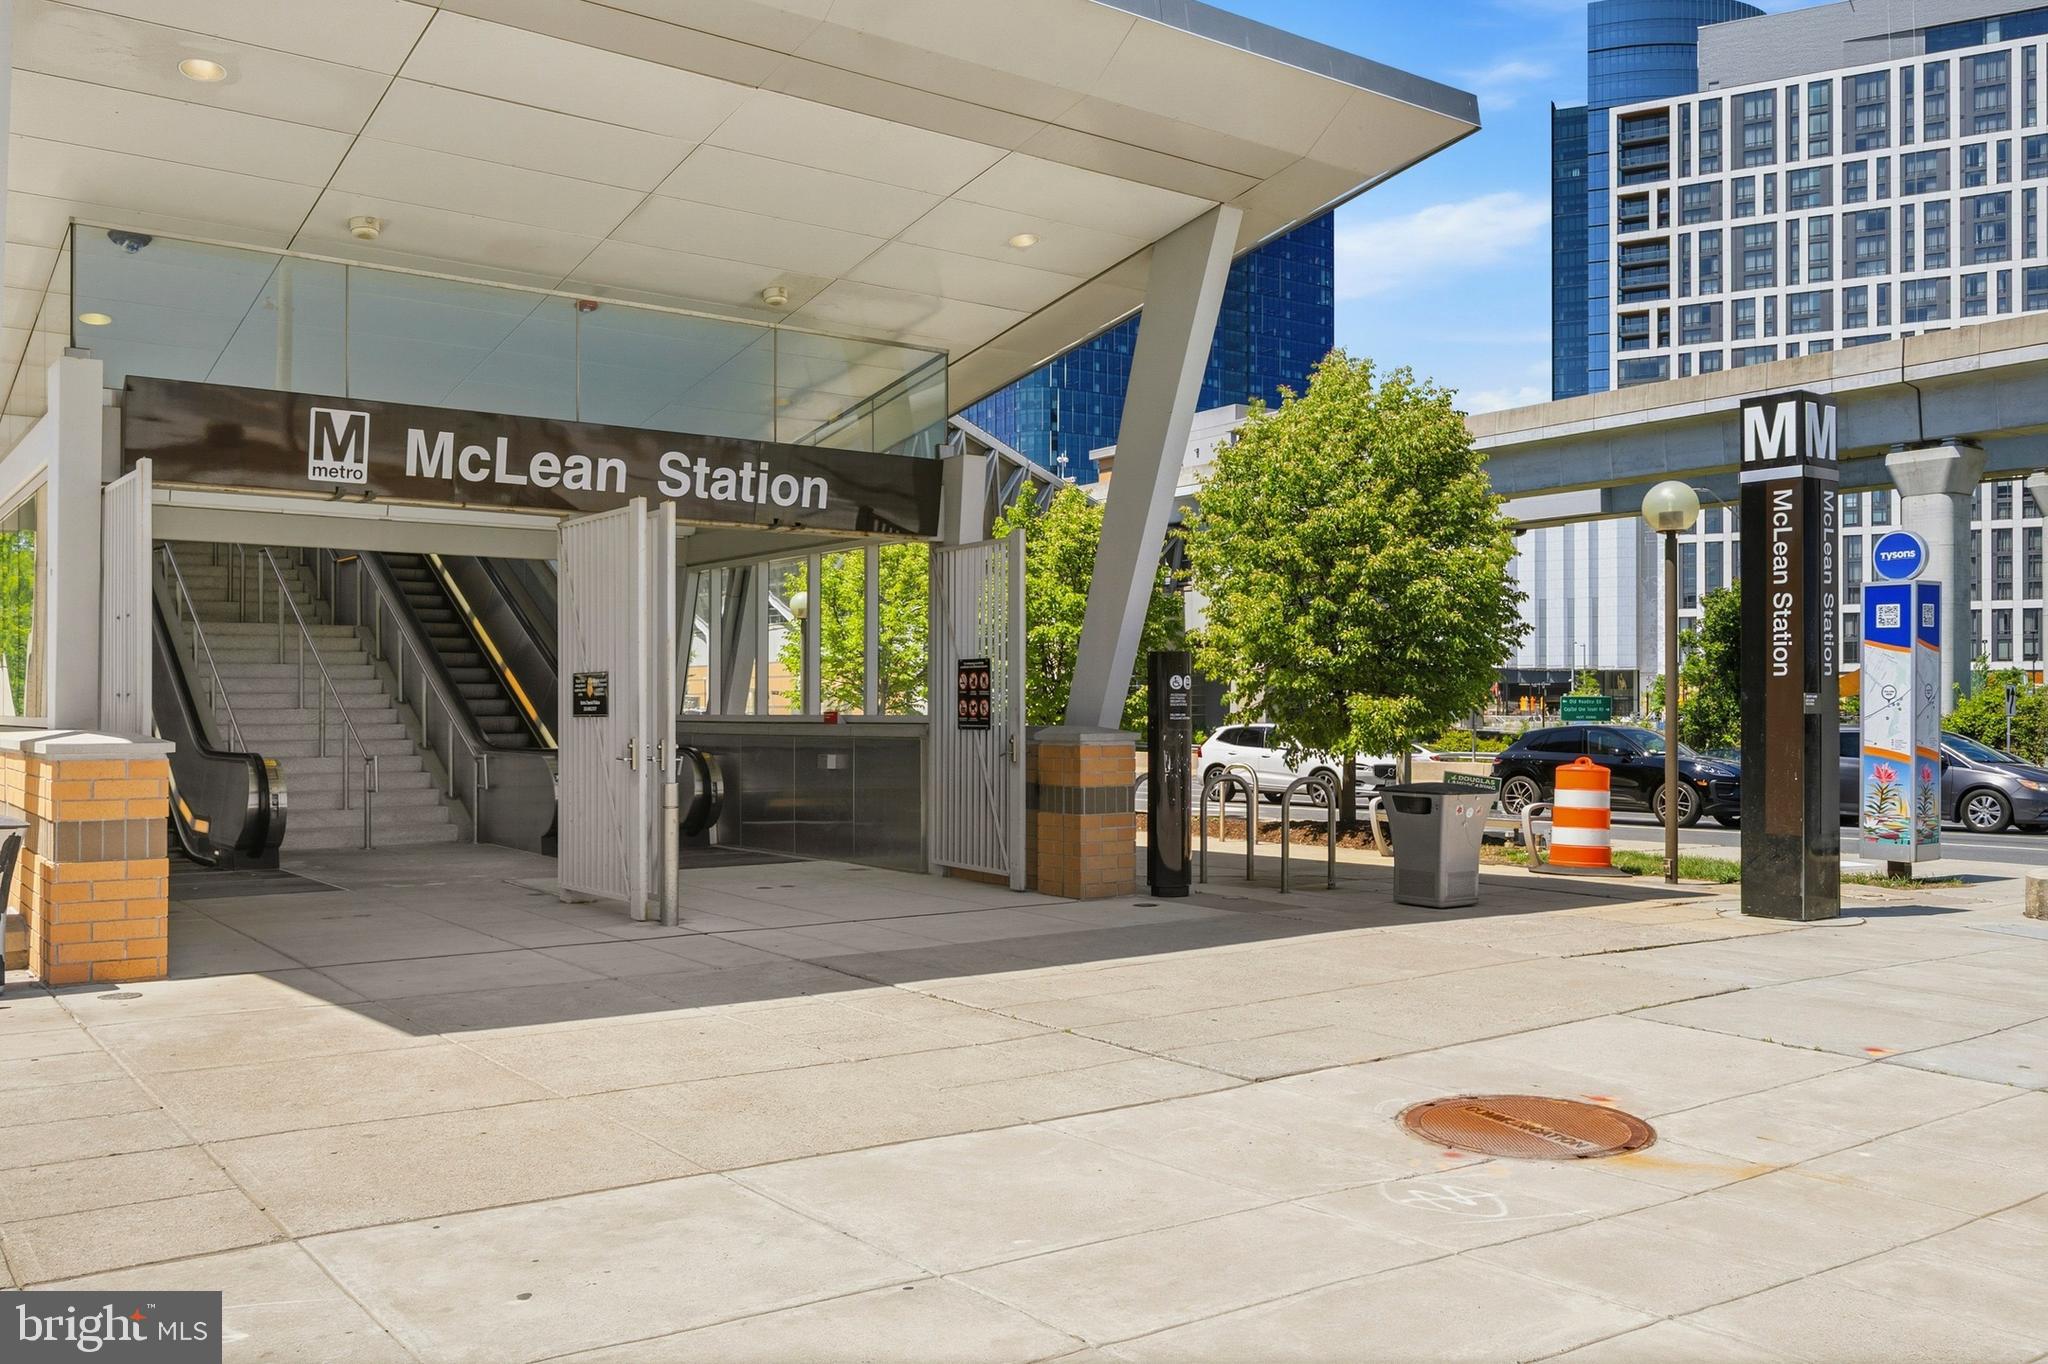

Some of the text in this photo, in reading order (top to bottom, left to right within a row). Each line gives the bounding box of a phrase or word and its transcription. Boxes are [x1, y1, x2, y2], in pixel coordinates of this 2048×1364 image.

[313, 411, 365, 464] M
[1744, 401, 1797, 462] M
[1805, 401, 1836, 461] M
[312, 465, 364, 481] metro
[405, 428, 828, 510] McLean Station
[1773, 489, 1793, 677] McLean Station
[1823, 490, 1835, 677] McLean Station
[1458, 775, 1496, 785] DOUGLAS
